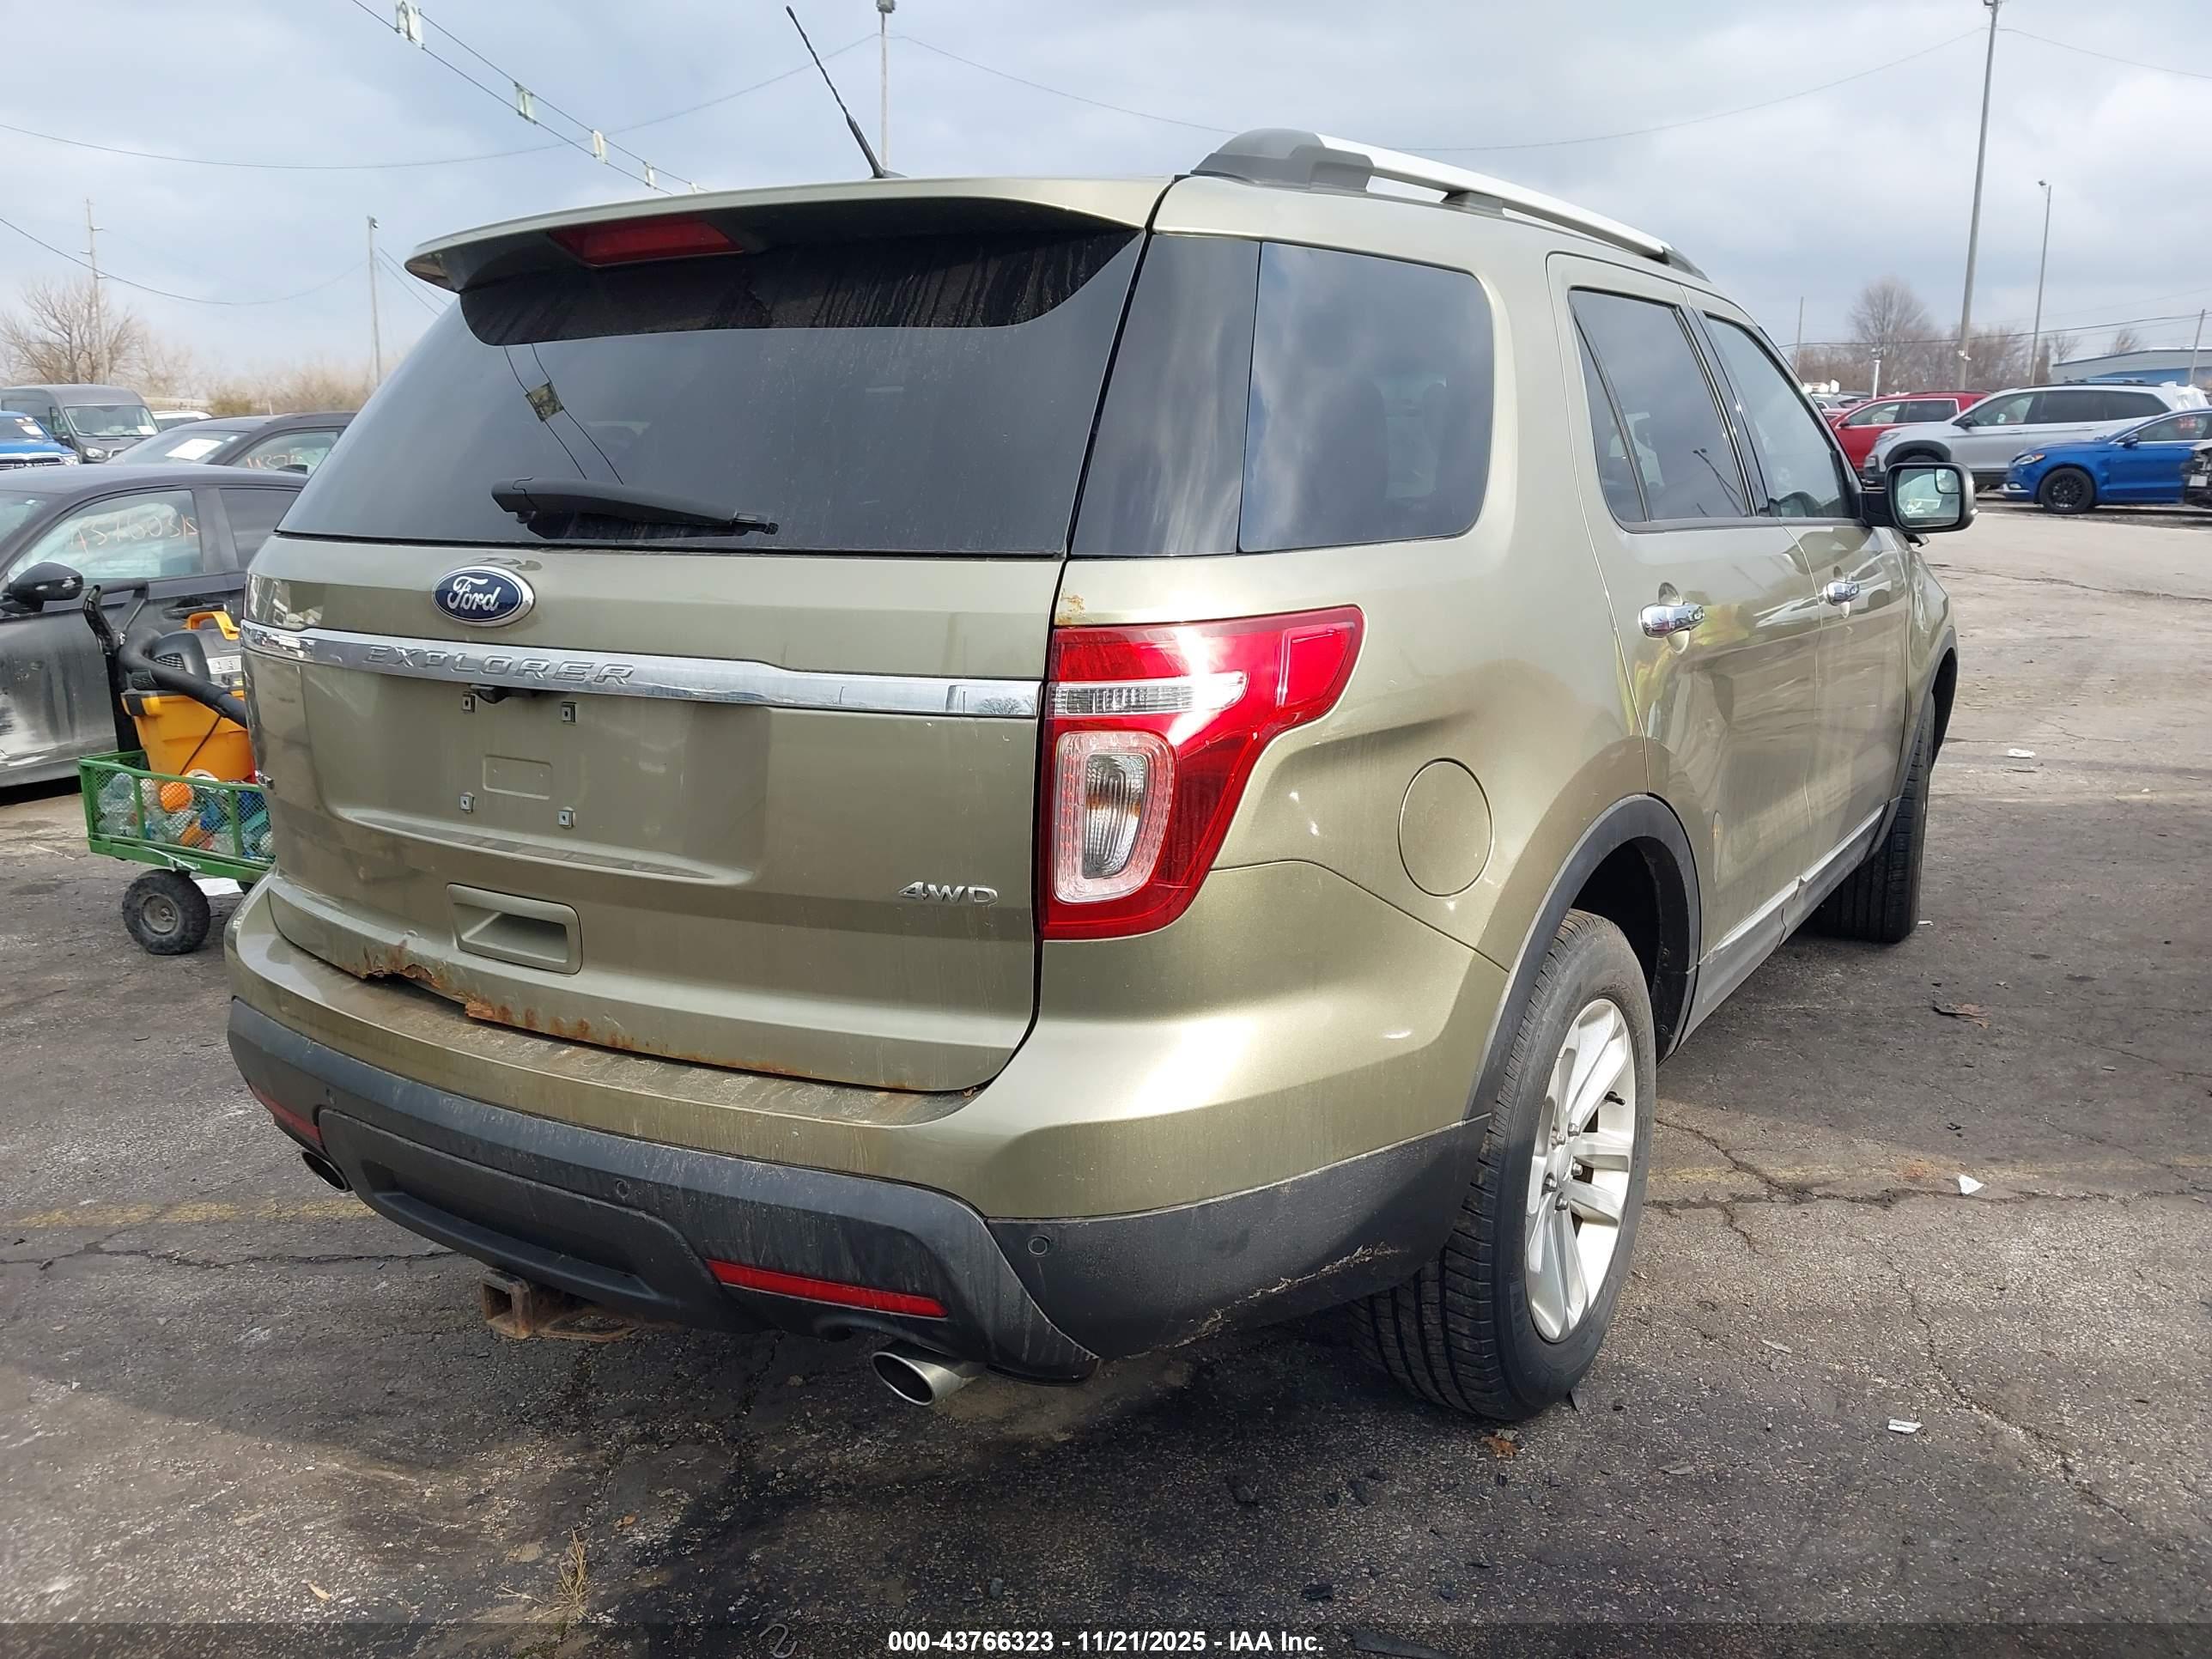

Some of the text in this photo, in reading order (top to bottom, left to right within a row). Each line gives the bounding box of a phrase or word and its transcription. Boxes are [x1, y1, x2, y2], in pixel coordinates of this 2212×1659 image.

[447, 575, 502, 611] Ford
[362, 644, 635, 685] EXPLORER
[898, 880, 999, 907] 4WD
